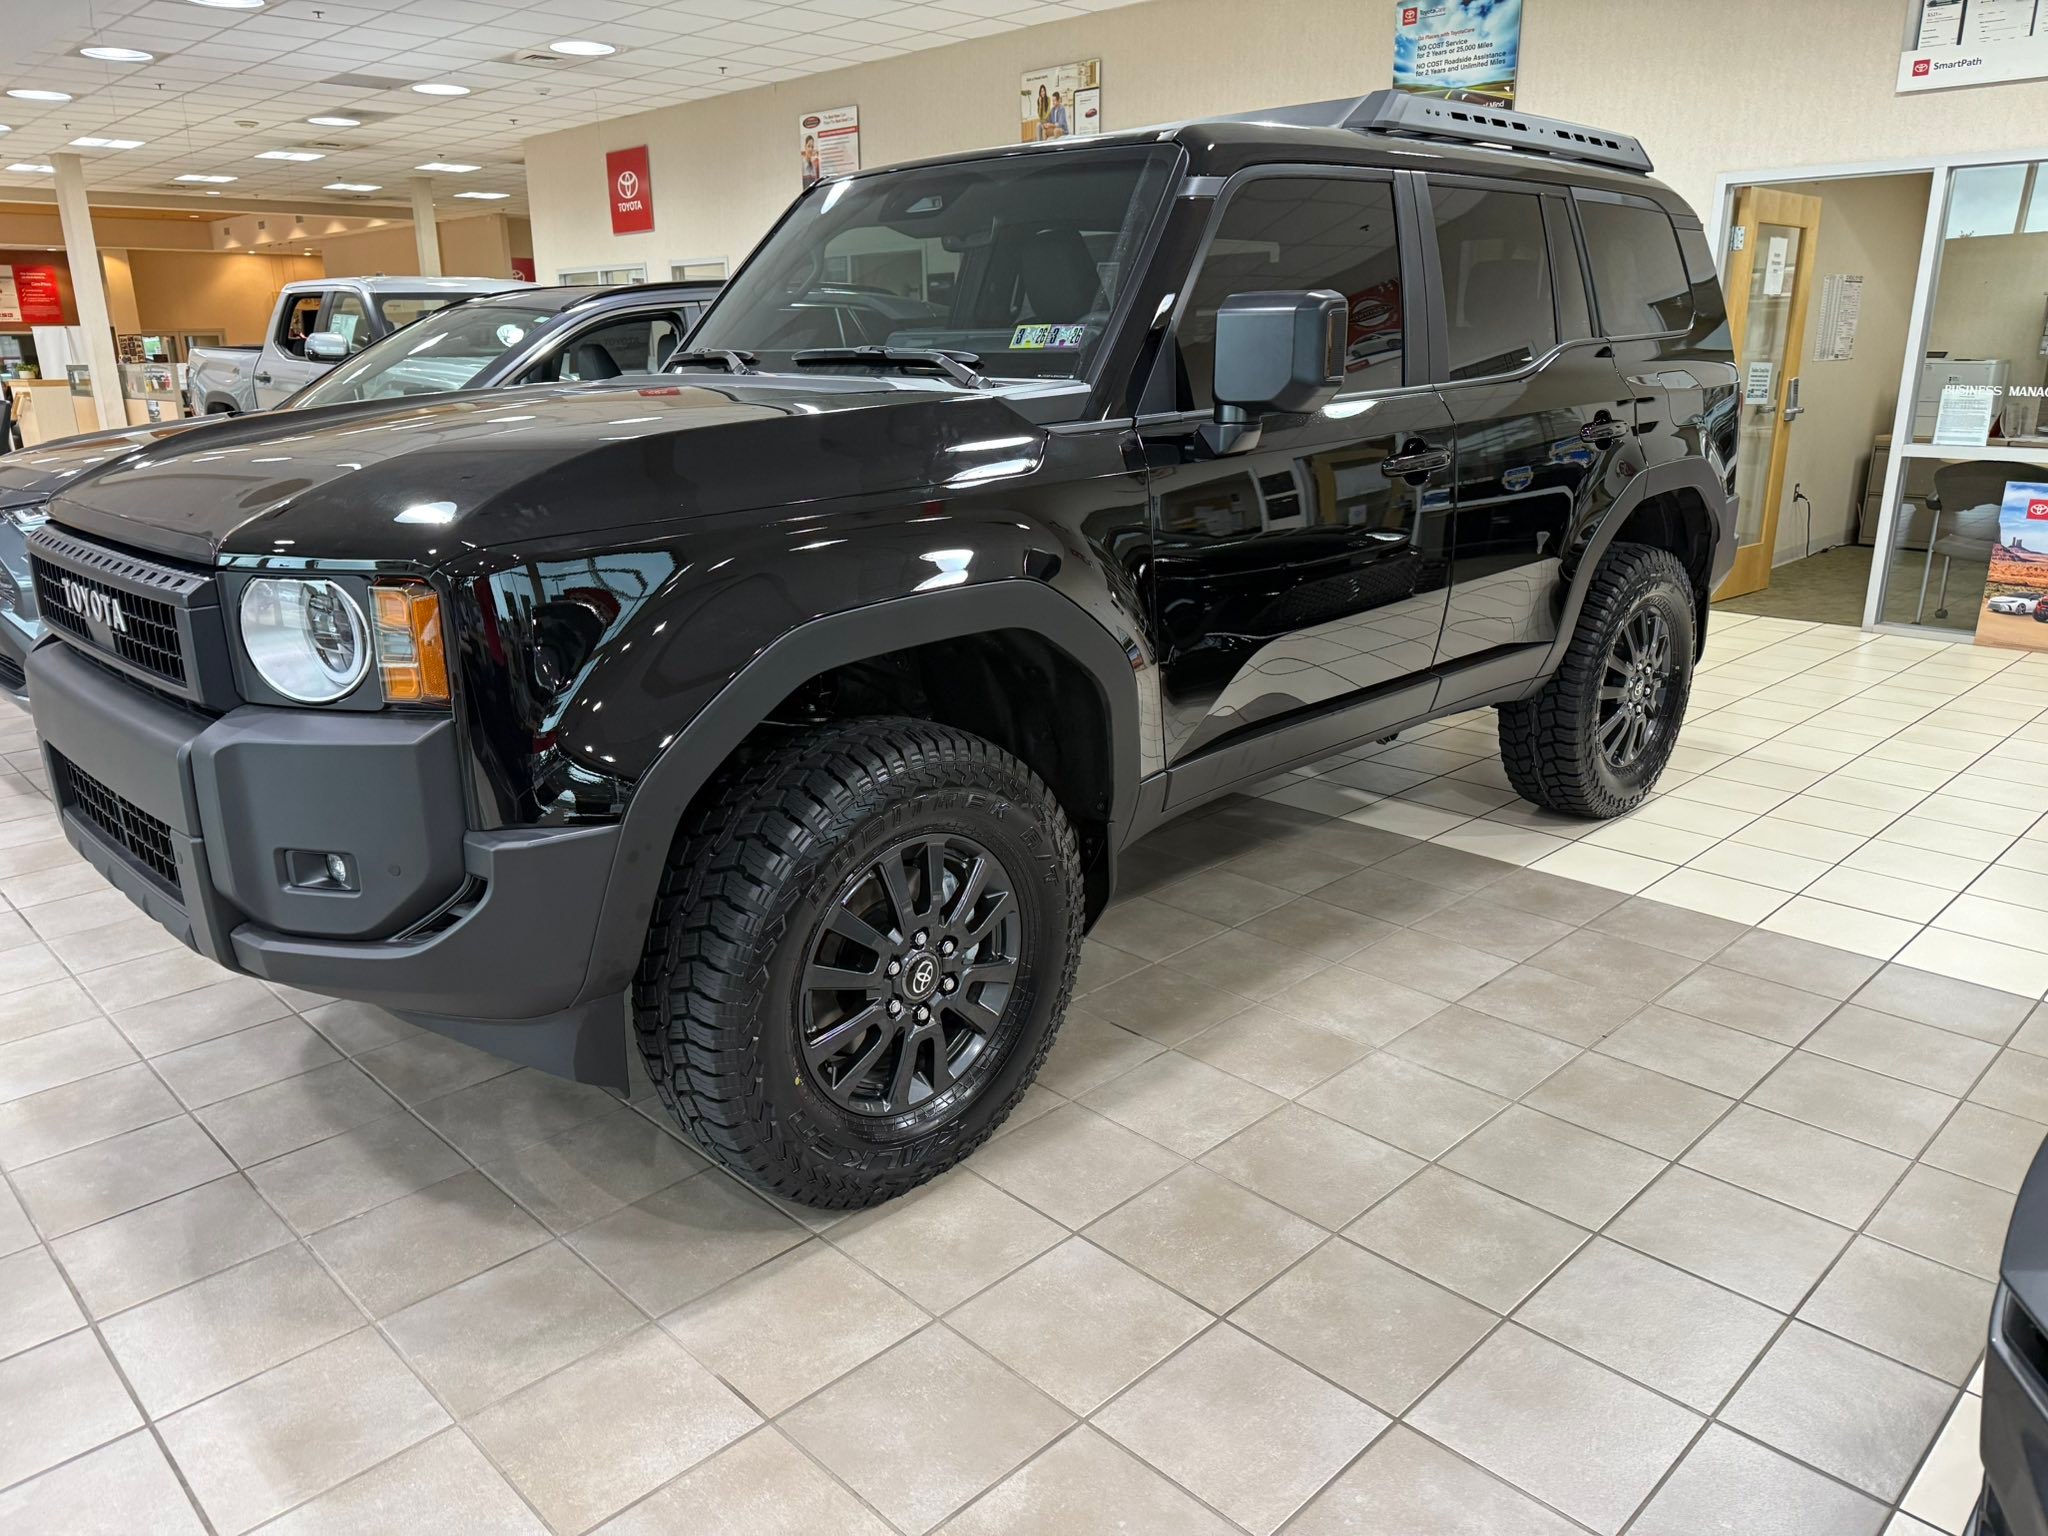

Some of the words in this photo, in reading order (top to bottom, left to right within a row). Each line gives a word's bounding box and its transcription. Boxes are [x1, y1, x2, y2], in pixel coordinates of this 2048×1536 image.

[1420, 7, 1446, 16] ToyotaCare
[1450, 28, 1475, 36] ToyotaCare
[1428, 41, 1444, 50] COST
[1446, 39, 1468, 47] Service
[1456, 44, 1476, 53] 25,000
[1427, 60, 1443, 68] COST
[1444, 56, 1472, 66] Roadside
[1473, 51, 1507, 61] Assistance
[1460, 60, 1489, 70] Unlimited
[1490, 58, 1506, 66] Miles
[1933, 57, 1982, 71] SmartPath
[1489, 99, 1505, 108] Mind
[617, 200, 643, 213] TOYOTA
[1016, 328, 1026, 344] 3
[1035, 327, 1048, 344] 26
[1050, 328, 1060, 344] 3
[1070, 327, 1083, 344] 26
[1944, 384, 2003, 397] BUSINESS
[61, 578, 128, 632] TOYOTA
[806, 791, 1012, 904] RUBITREK
